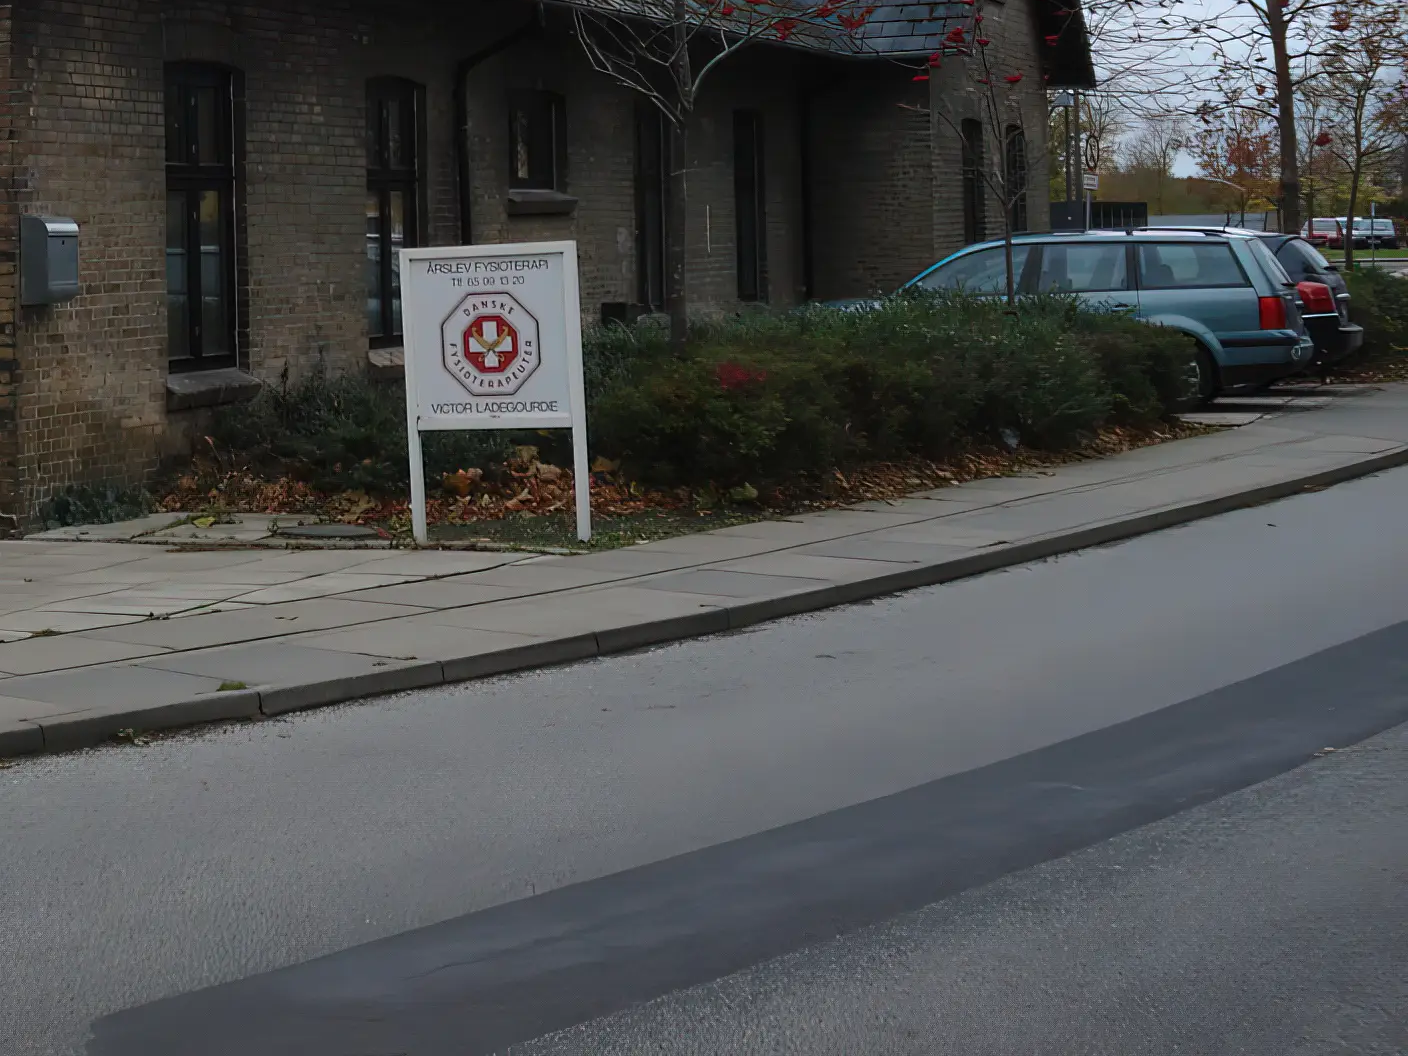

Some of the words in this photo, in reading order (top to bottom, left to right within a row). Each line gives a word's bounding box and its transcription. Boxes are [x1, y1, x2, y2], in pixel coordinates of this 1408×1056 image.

[426, 261, 472, 274] ÅRSLEV
[474, 259, 549, 273] FYSIOTERAPI
[463, 300, 515, 317] DANSKE
[449, 340, 533, 388] FYSIOTERAPEUTER
[431, 403, 473, 414] VICTOR
